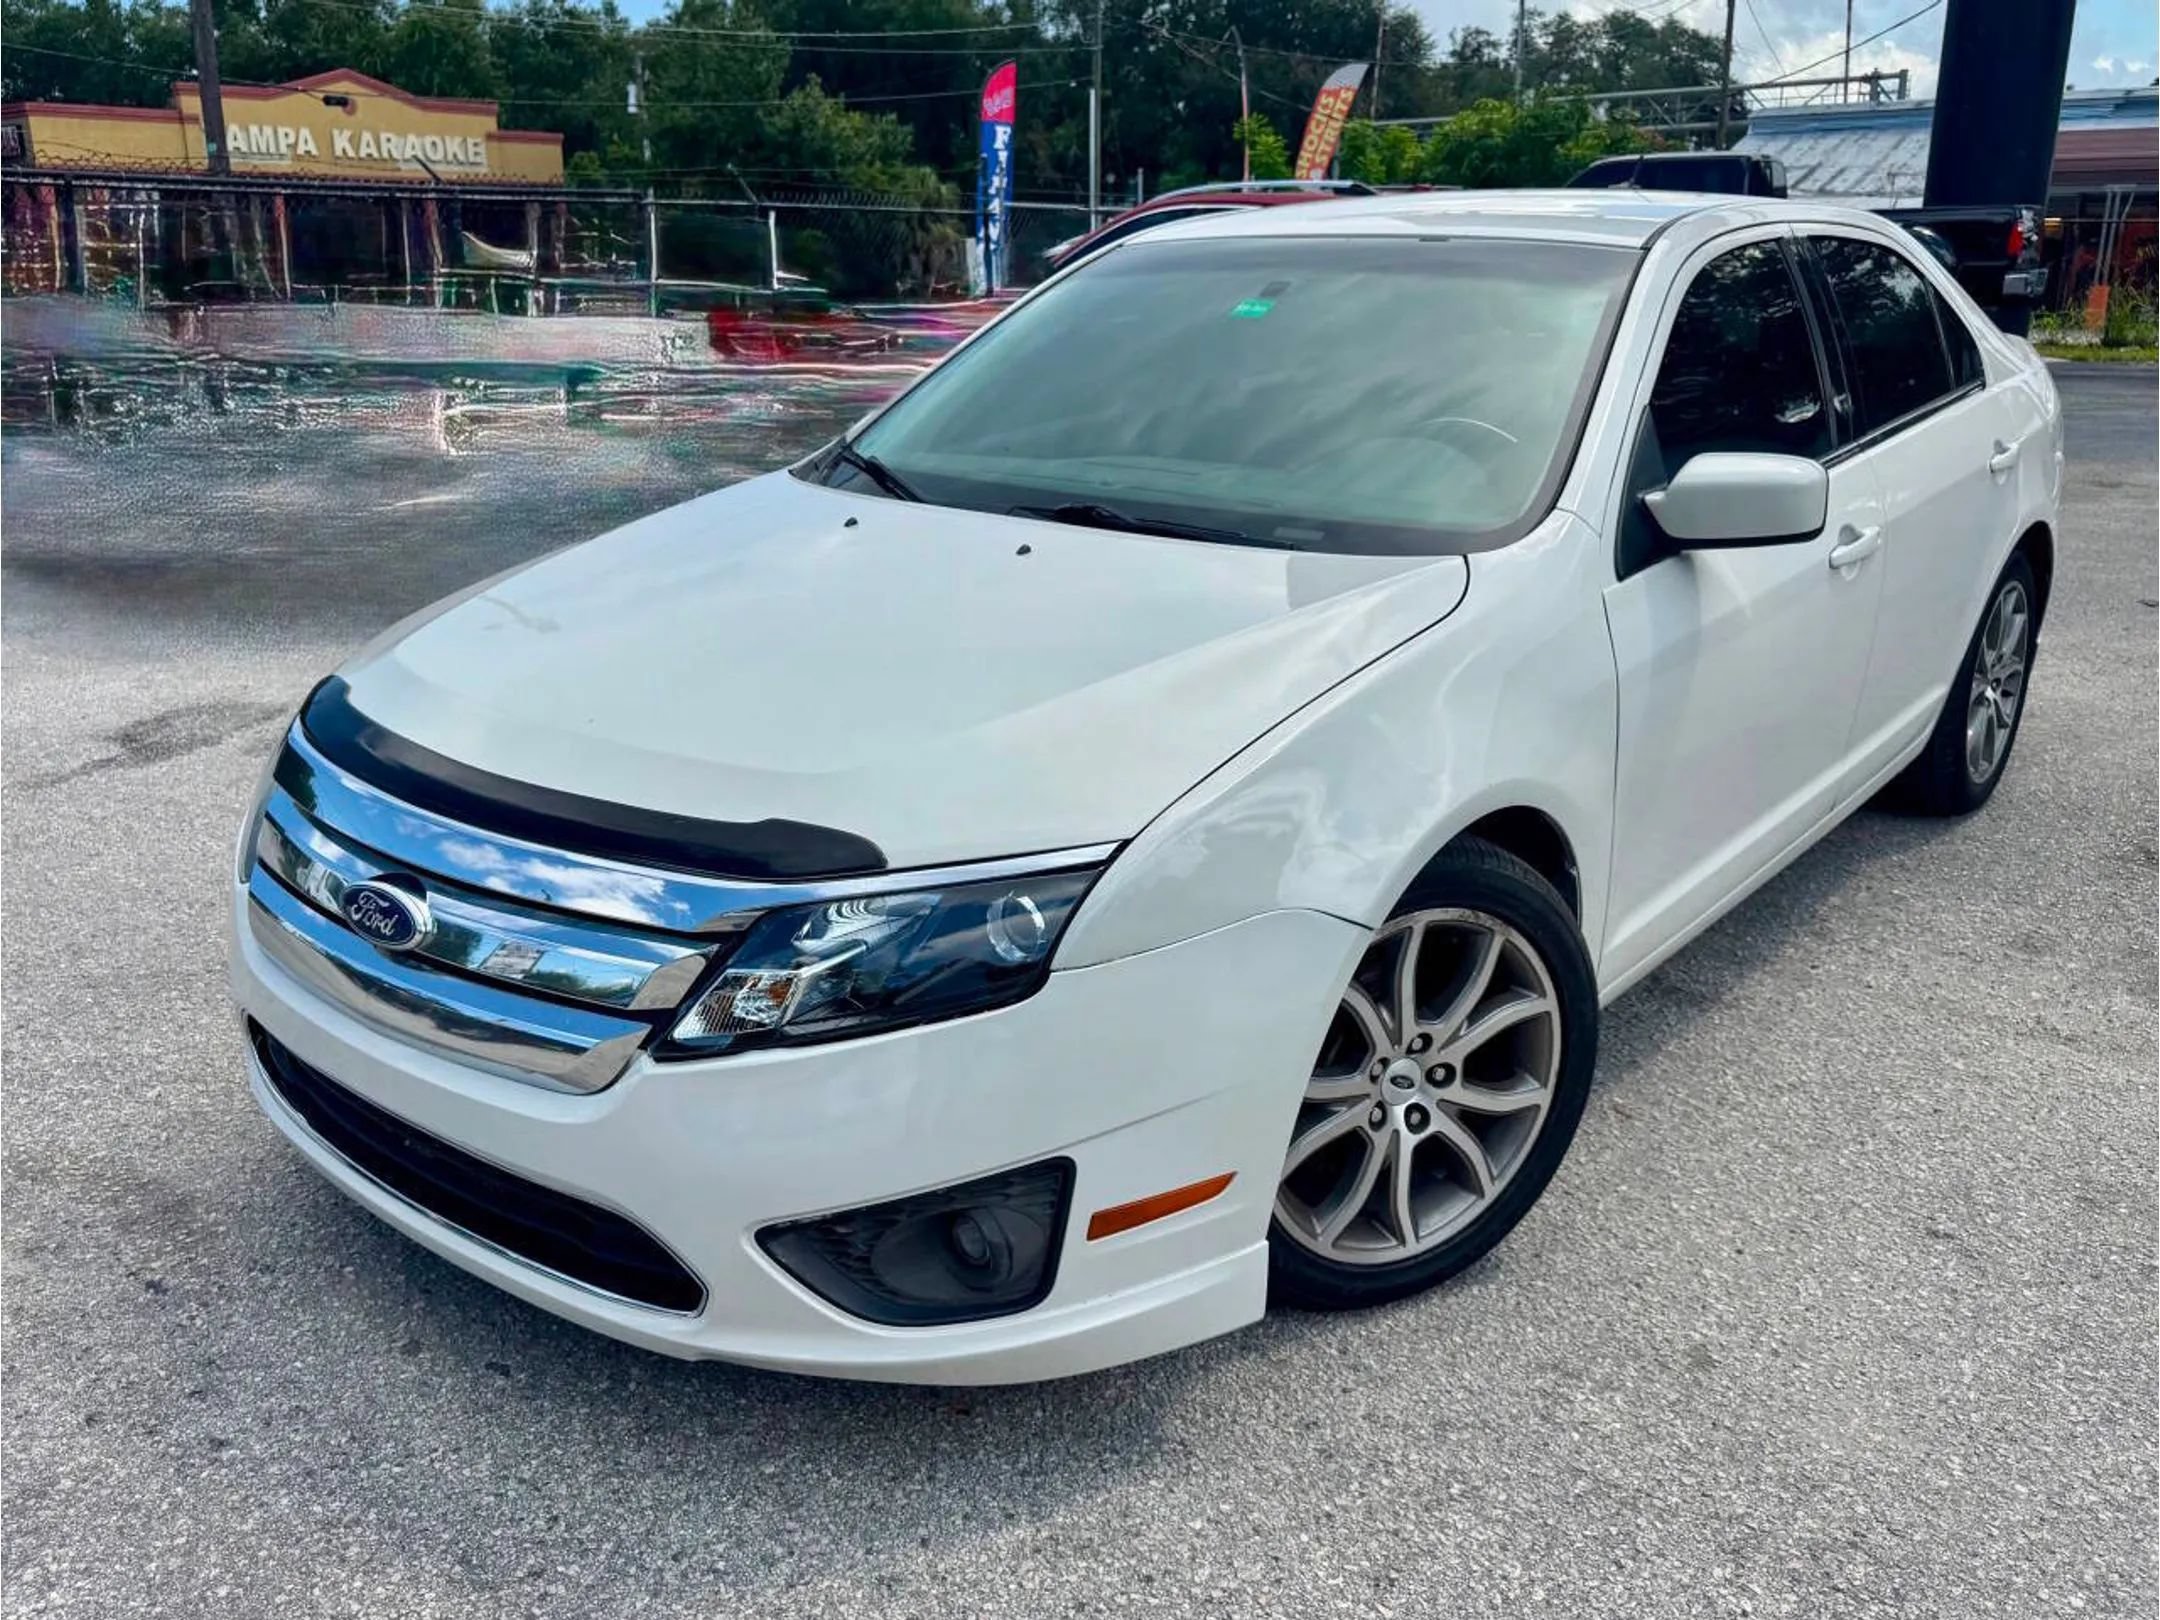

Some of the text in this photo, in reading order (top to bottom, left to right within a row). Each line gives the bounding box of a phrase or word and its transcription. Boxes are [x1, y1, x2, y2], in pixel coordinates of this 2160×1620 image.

[225, 123, 486, 166] AMPA KARAOKE
[1315, 88, 1355, 164] STRUTS
[350, 890, 398, 937] Ford
